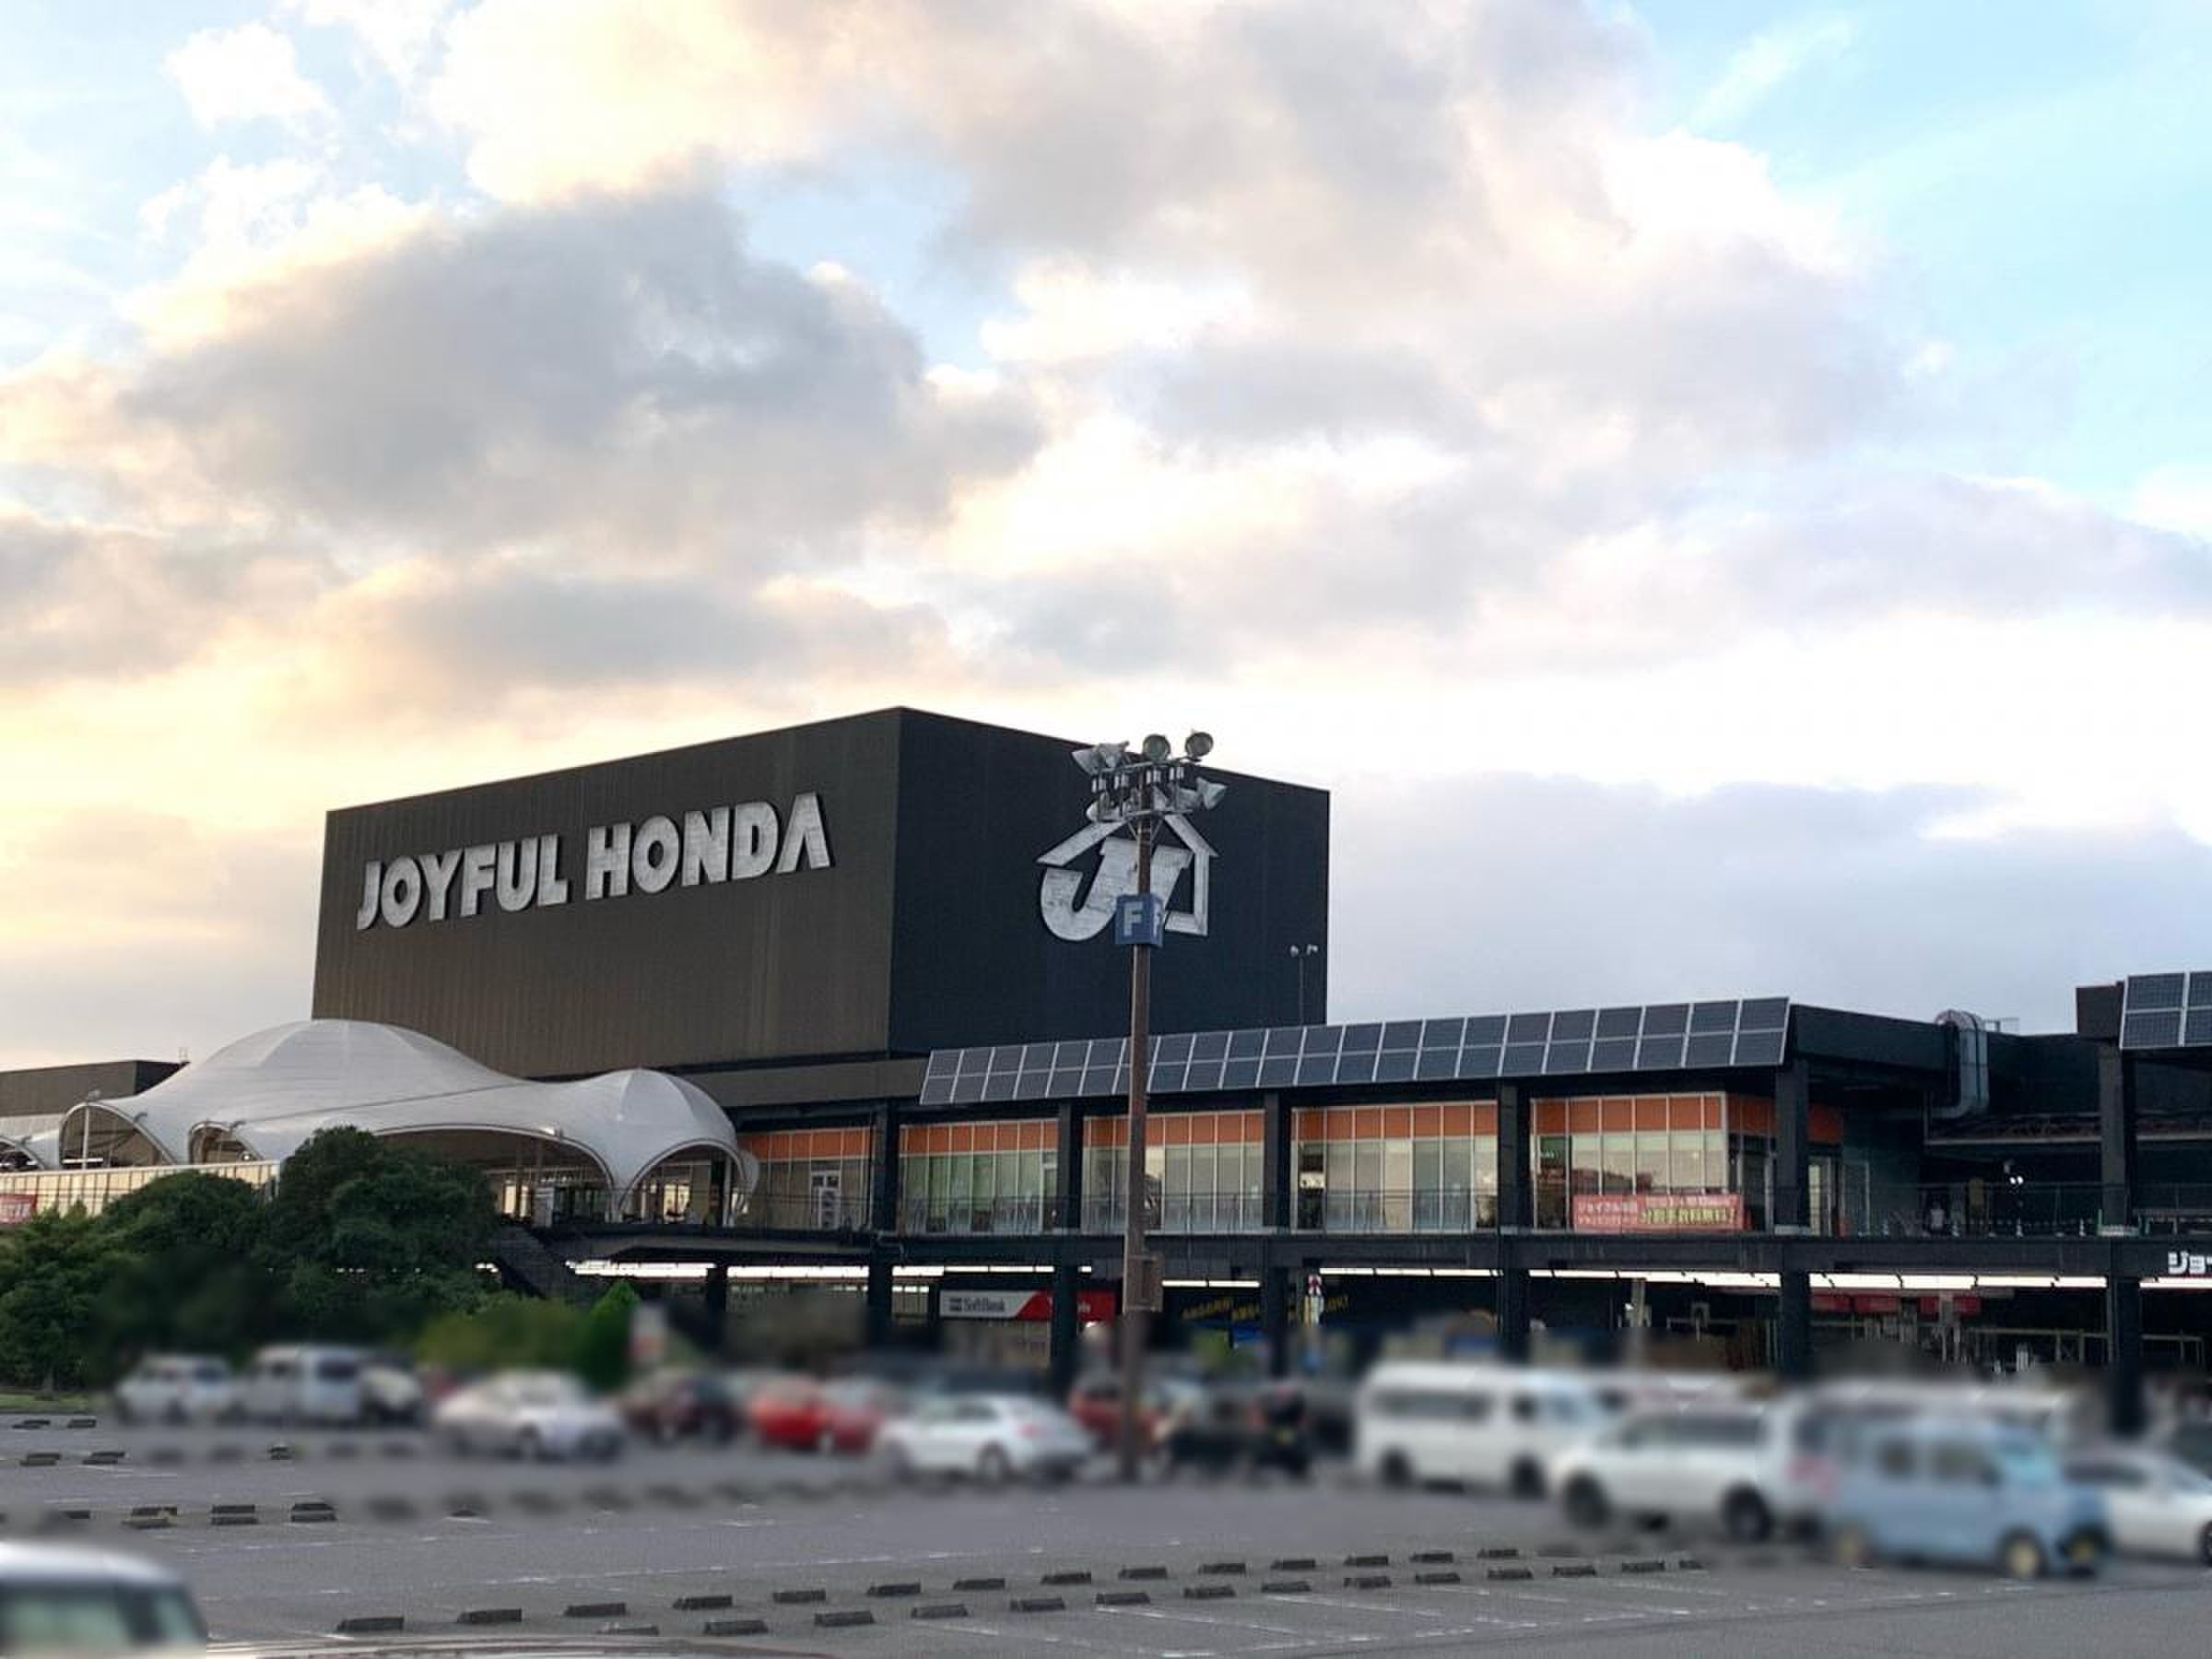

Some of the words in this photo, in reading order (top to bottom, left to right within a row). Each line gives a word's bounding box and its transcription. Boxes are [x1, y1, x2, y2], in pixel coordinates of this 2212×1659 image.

[357, 833, 568, 930] JOYFUL
[586, 792, 830, 900] HONDA
[1124, 900, 1144, 936] F
[2168, 1251, 2212, 1275] ジョ
